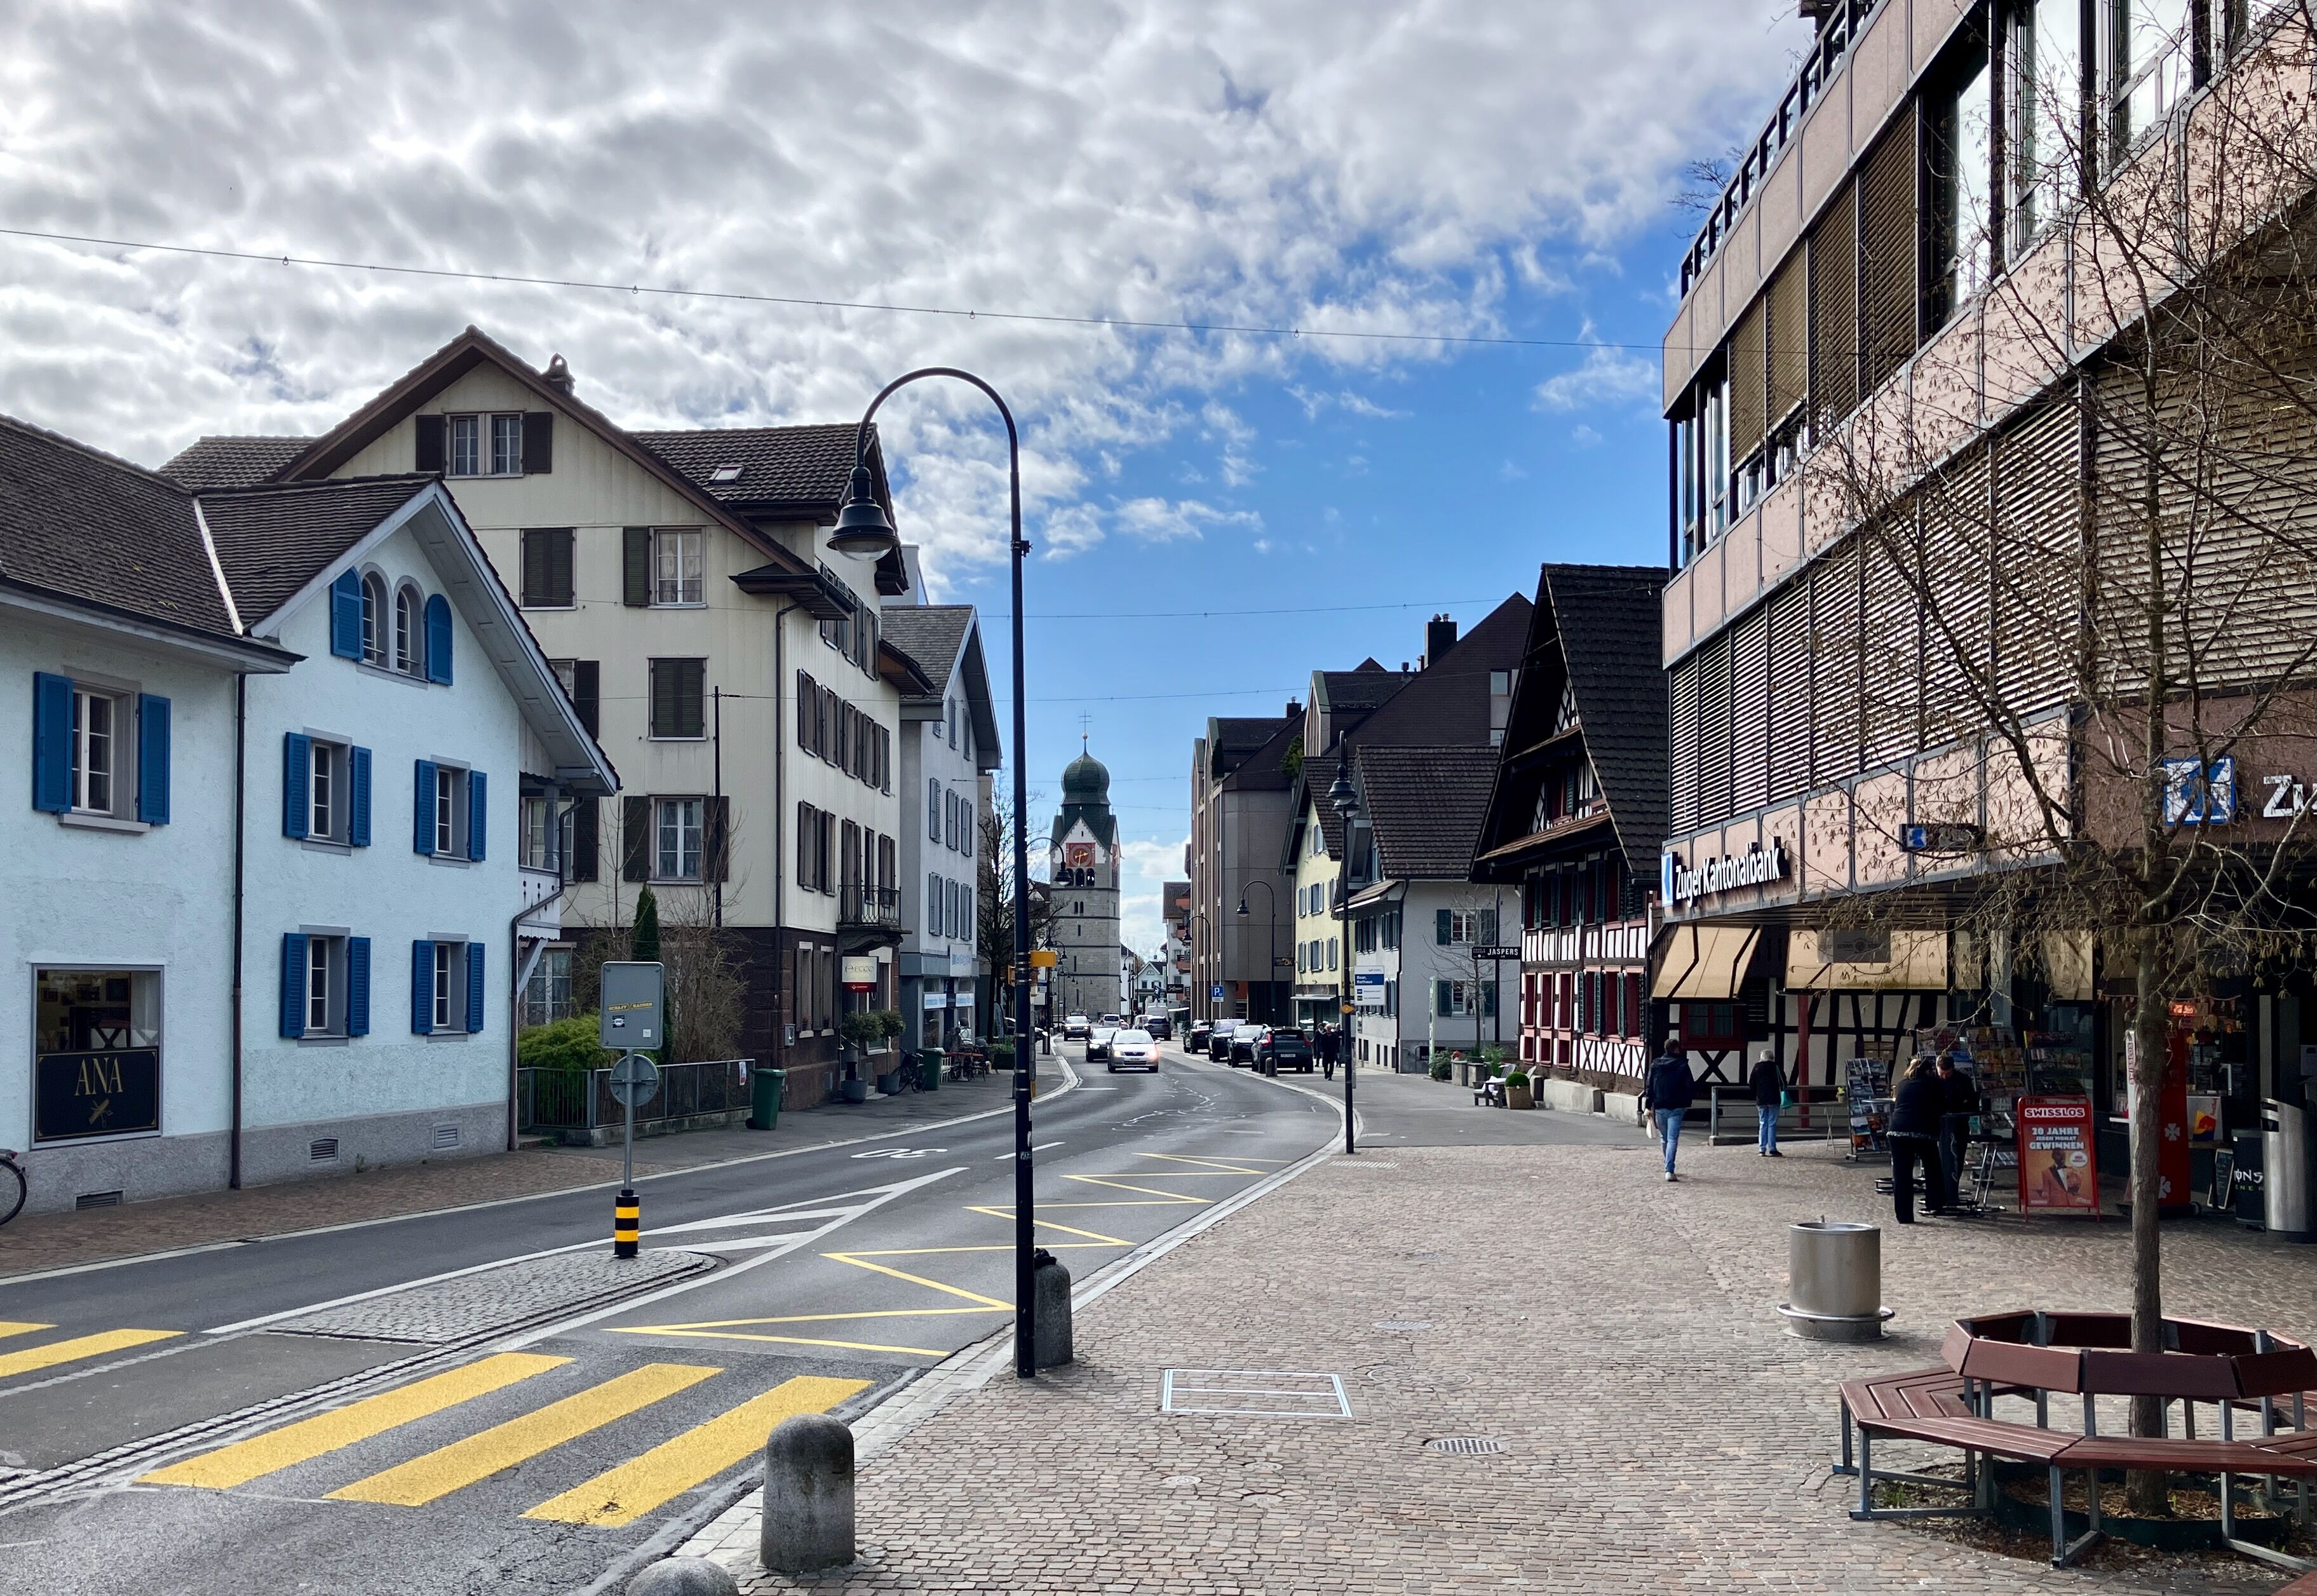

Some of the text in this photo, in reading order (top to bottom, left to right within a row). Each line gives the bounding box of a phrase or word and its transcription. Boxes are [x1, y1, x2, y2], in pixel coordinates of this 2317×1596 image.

[1214, 987, 1220, 996] P
[2127, 1042, 2136, 1085] SWISSLOS
[74, 1057, 123, 1096] ANA
[2025, 1107, 2085, 1118] SWISSLOS
[2032, 1127, 2080, 1135] 20 JAHRE
[2029, 1142, 2085, 1150] GEWINNEN
